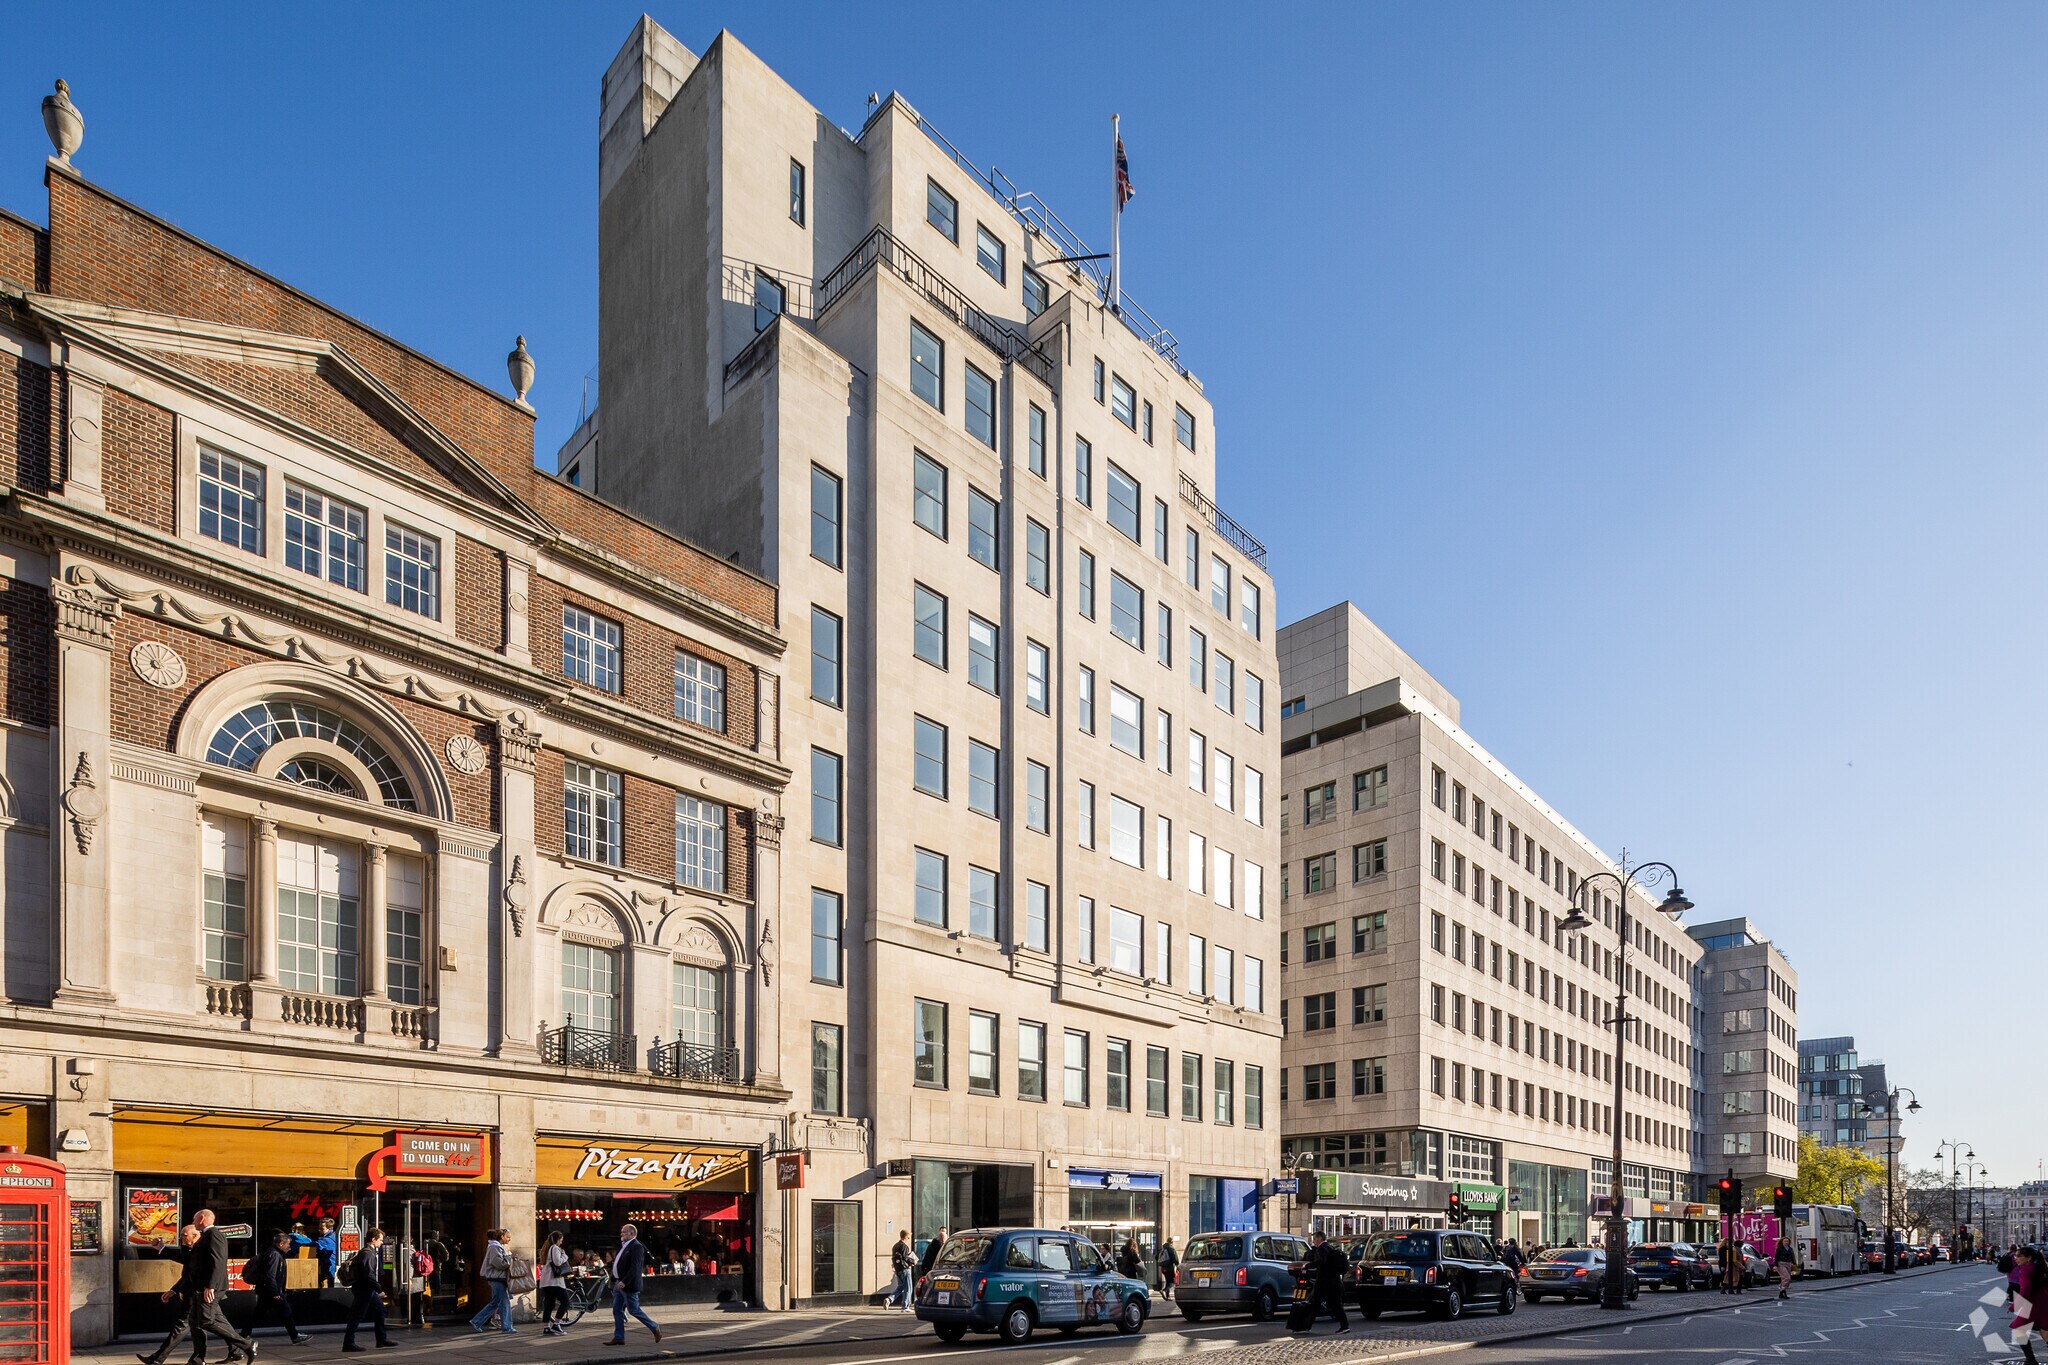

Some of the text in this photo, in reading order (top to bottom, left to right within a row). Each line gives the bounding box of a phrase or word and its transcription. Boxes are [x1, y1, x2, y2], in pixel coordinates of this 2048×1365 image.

[411, 1140, 471, 1152] COME ON IN
[402, 1152, 479, 1167] TO YOUR Hut
[576, 1147, 722, 1181] Pizza Hut
[778, 1162, 797, 1175] Pizza
[781, 1172, 795, 1183] Hut
[1108, 1176, 1131, 1184] HALIFAX
[130, 1190, 169, 1203] Melts
[1361, 1181, 1409, 1201] Superdrug
[1463, 1190, 1498, 1203] LLOYDS BANK
[290, 1193, 351, 1219] Hut
[1000, 1282, 1024, 1292] viator
